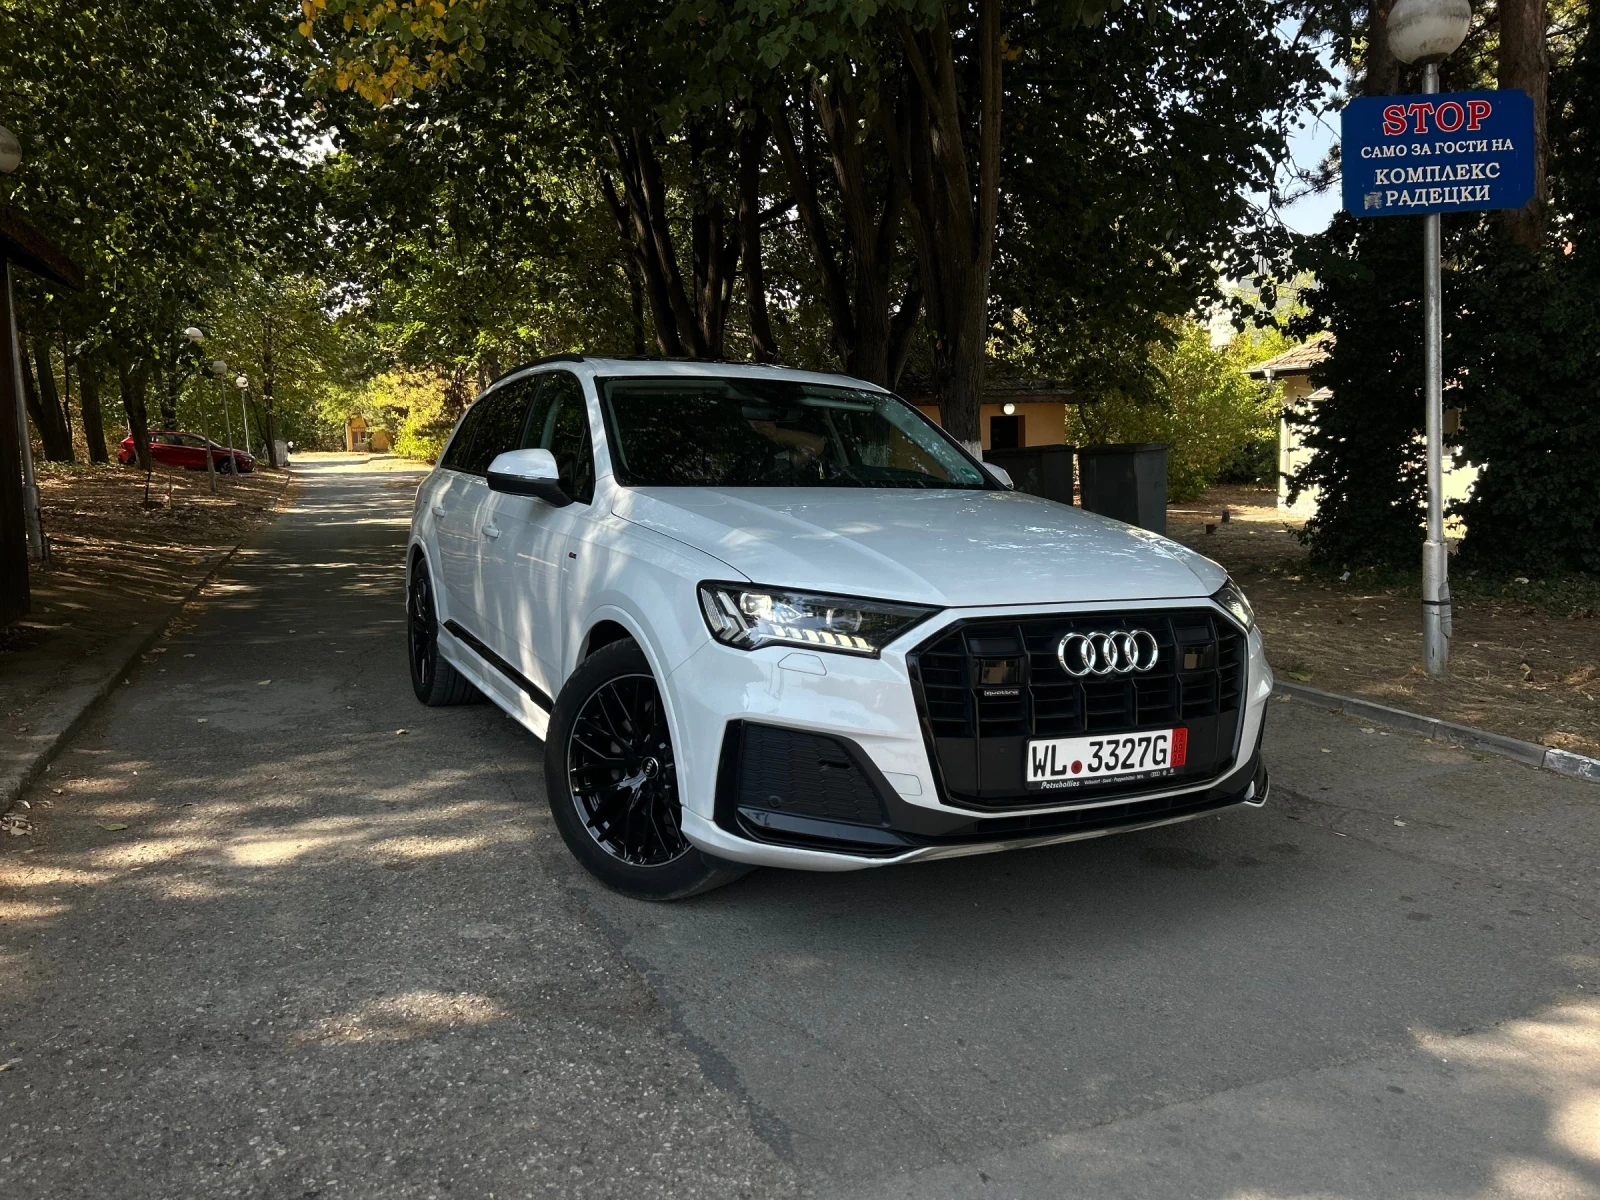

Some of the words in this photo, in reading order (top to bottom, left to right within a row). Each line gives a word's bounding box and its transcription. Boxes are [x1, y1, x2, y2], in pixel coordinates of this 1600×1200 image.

[1382, 100, 1492, 135] STOP
[1360, 144, 1407, 158] САМО
[1411, 143, 1432, 155] ЗА
[1435, 139, 1488, 154] ГОСТИ
[1492, 138, 1514, 151] НА
[1375, 162, 1501, 185] КОМПЛЕКС
[1385, 184, 1490, 207] РАДЕЦКИ
[1087, 734, 1168, 773] 3327G
